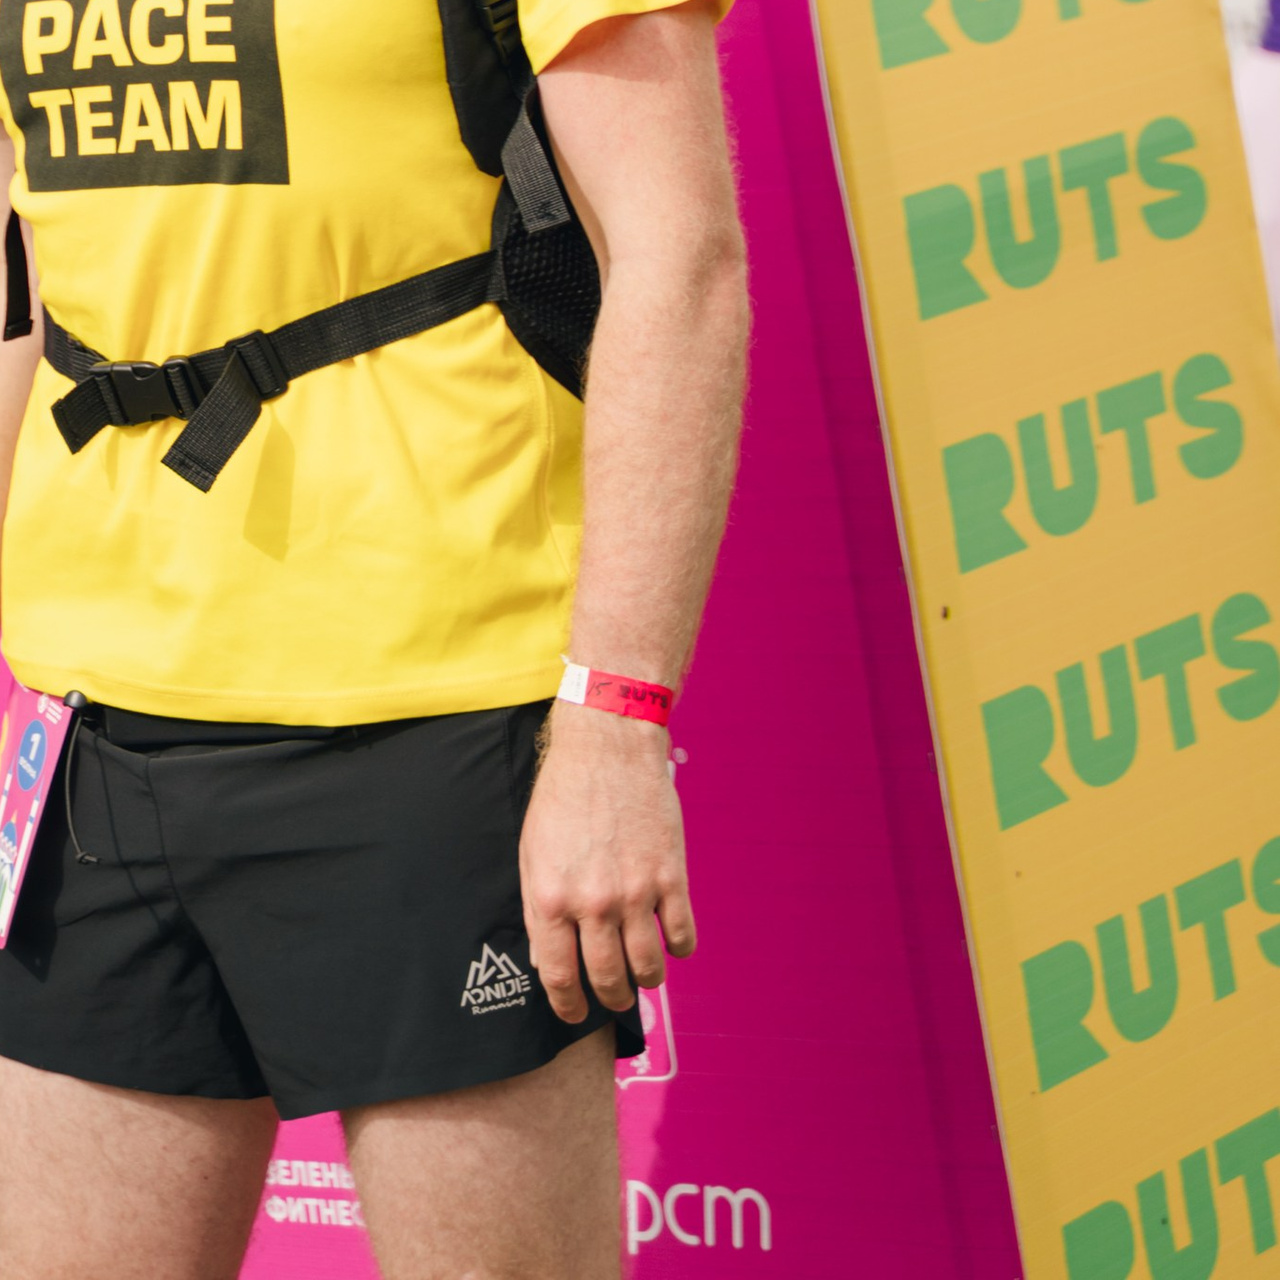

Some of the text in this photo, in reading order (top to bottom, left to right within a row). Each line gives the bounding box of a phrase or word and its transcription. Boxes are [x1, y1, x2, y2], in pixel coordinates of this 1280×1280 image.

[28, 80, 243, 157] TEAM
[902, 115, 1208, 322] RUTS
[941, 352, 1244, 575] RUTS
[30, 732, 41, 761] 1
[980, 592, 1280, 832] RUTS
[472, 996, 526, 1015] Running
